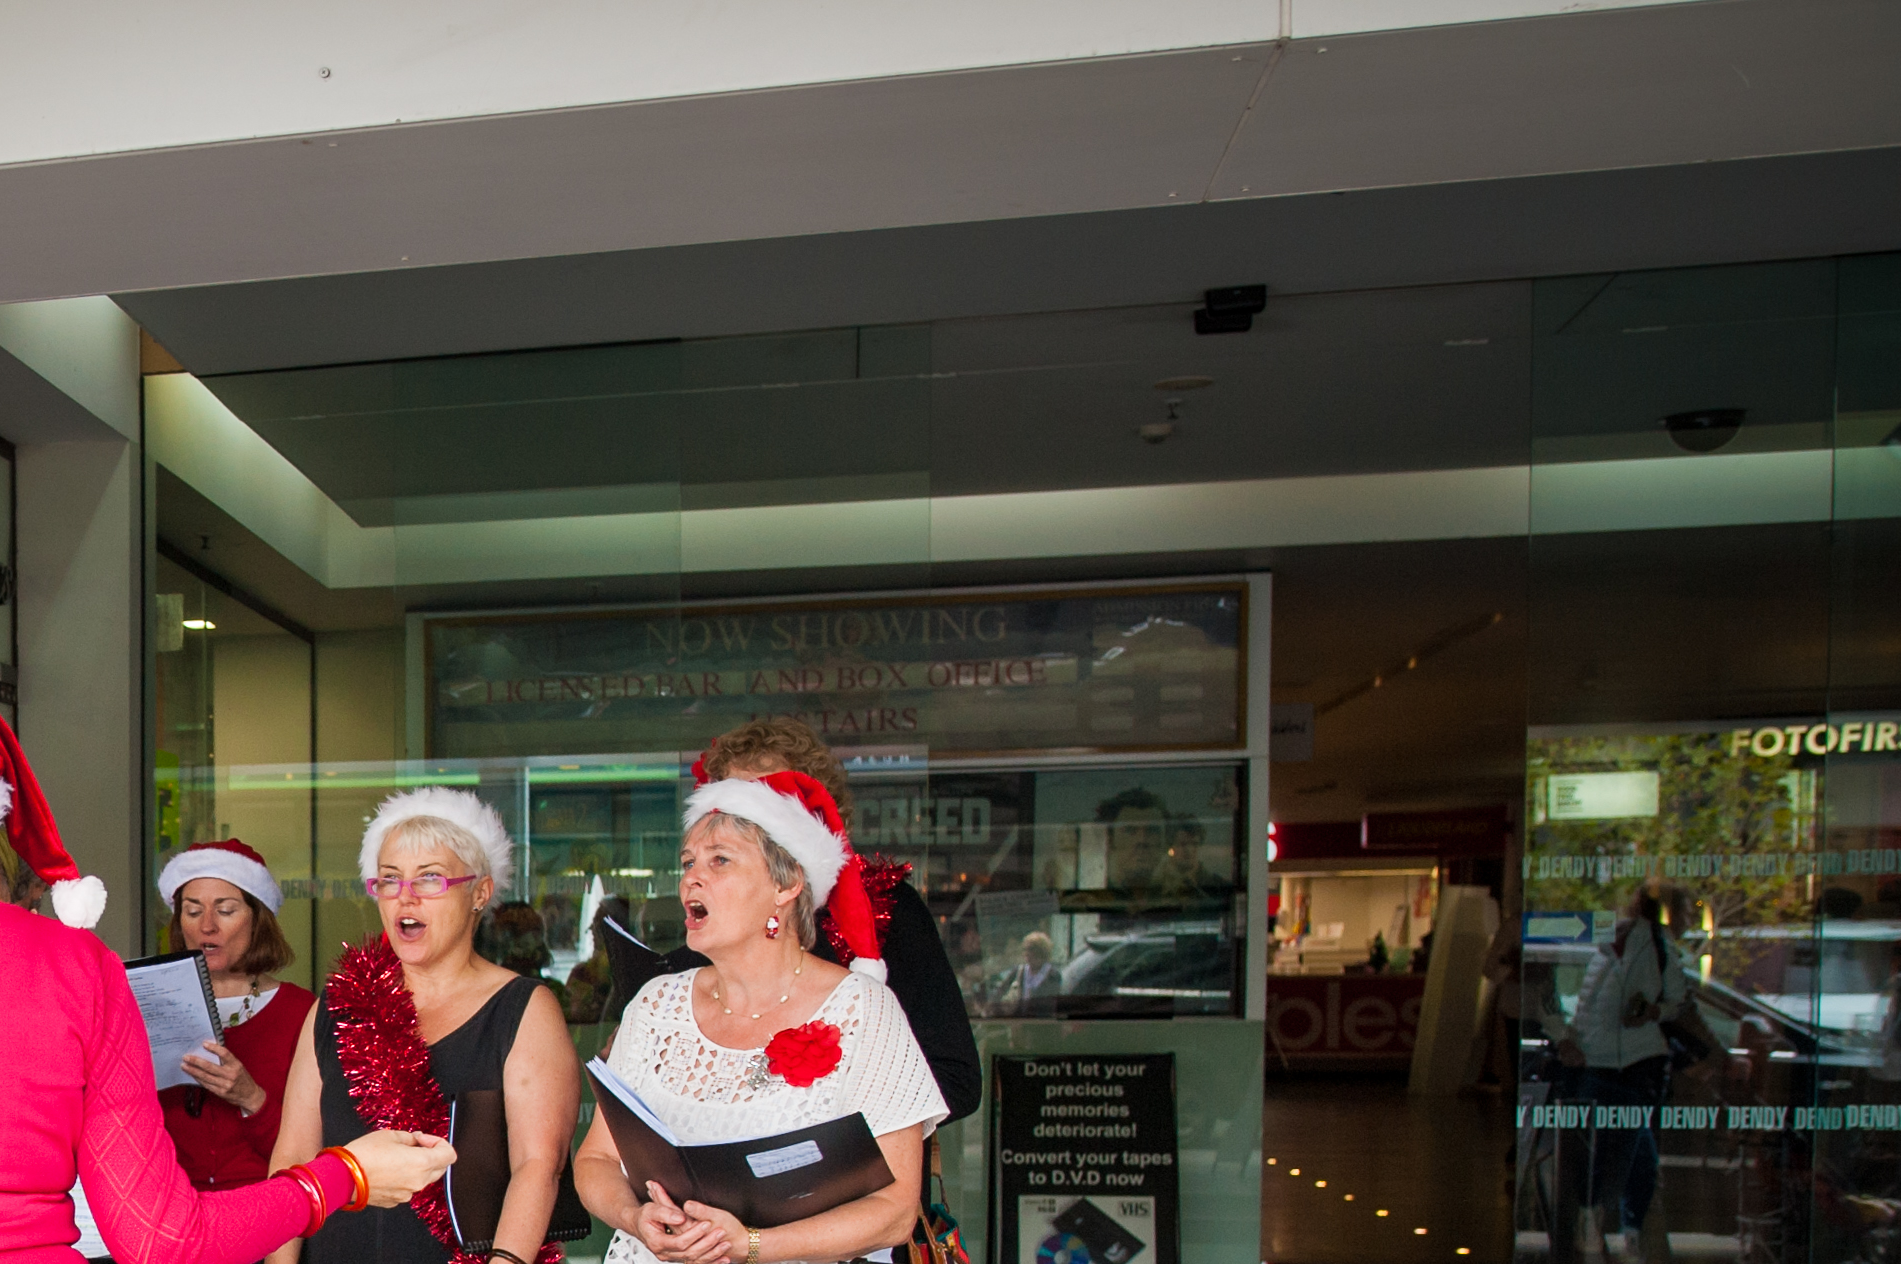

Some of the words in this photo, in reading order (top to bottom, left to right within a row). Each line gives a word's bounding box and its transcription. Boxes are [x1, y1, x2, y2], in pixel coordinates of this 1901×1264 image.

[646, 617, 755, 655] NOW
[771, 608, 1007, 650] SHOWING
[486, 673, 646, 704] LICENSED
[656, 670, 722, 698] BAR
[749, 666, 824, 695] AND
[836, 663, 909, 691] BOX
[927, 657, 1047, 688] OFFICE
[749, 706, 918, 734] TAIRS
[1729, 721, 1901, 758] FOTOFIR
[852, 798, 992, 846] CREED
[1537, 855, 1597, 880] DENDY
[1024, 1061, 1072, 1078] Don't
[1077, 1061, 1100, 1077] let
[1104, 1064, 1146, 1080] your
[1045, 1081, 1124, 1100] precious
[1040, 1101, 1131, 1118] memories
[1532, 1104, 1591, 1129] DENDY
[1595, 1104, 1653, 1129] DENDY
[1660, 1105, 1720, 1130] DENDY
[1728, 1105, 1788, 1130] DENDY
[1033, 1122, 1137, 1138] deteriorate!
[1001, 1150, 1072, 1166] Convert
[1076, 1152, 1118, 1168] your
[1122, 1151, 1173, 1169] tapes
[1028, 1171, 1047, 1186] to
[1105, 1173, 1145, 1187] now
